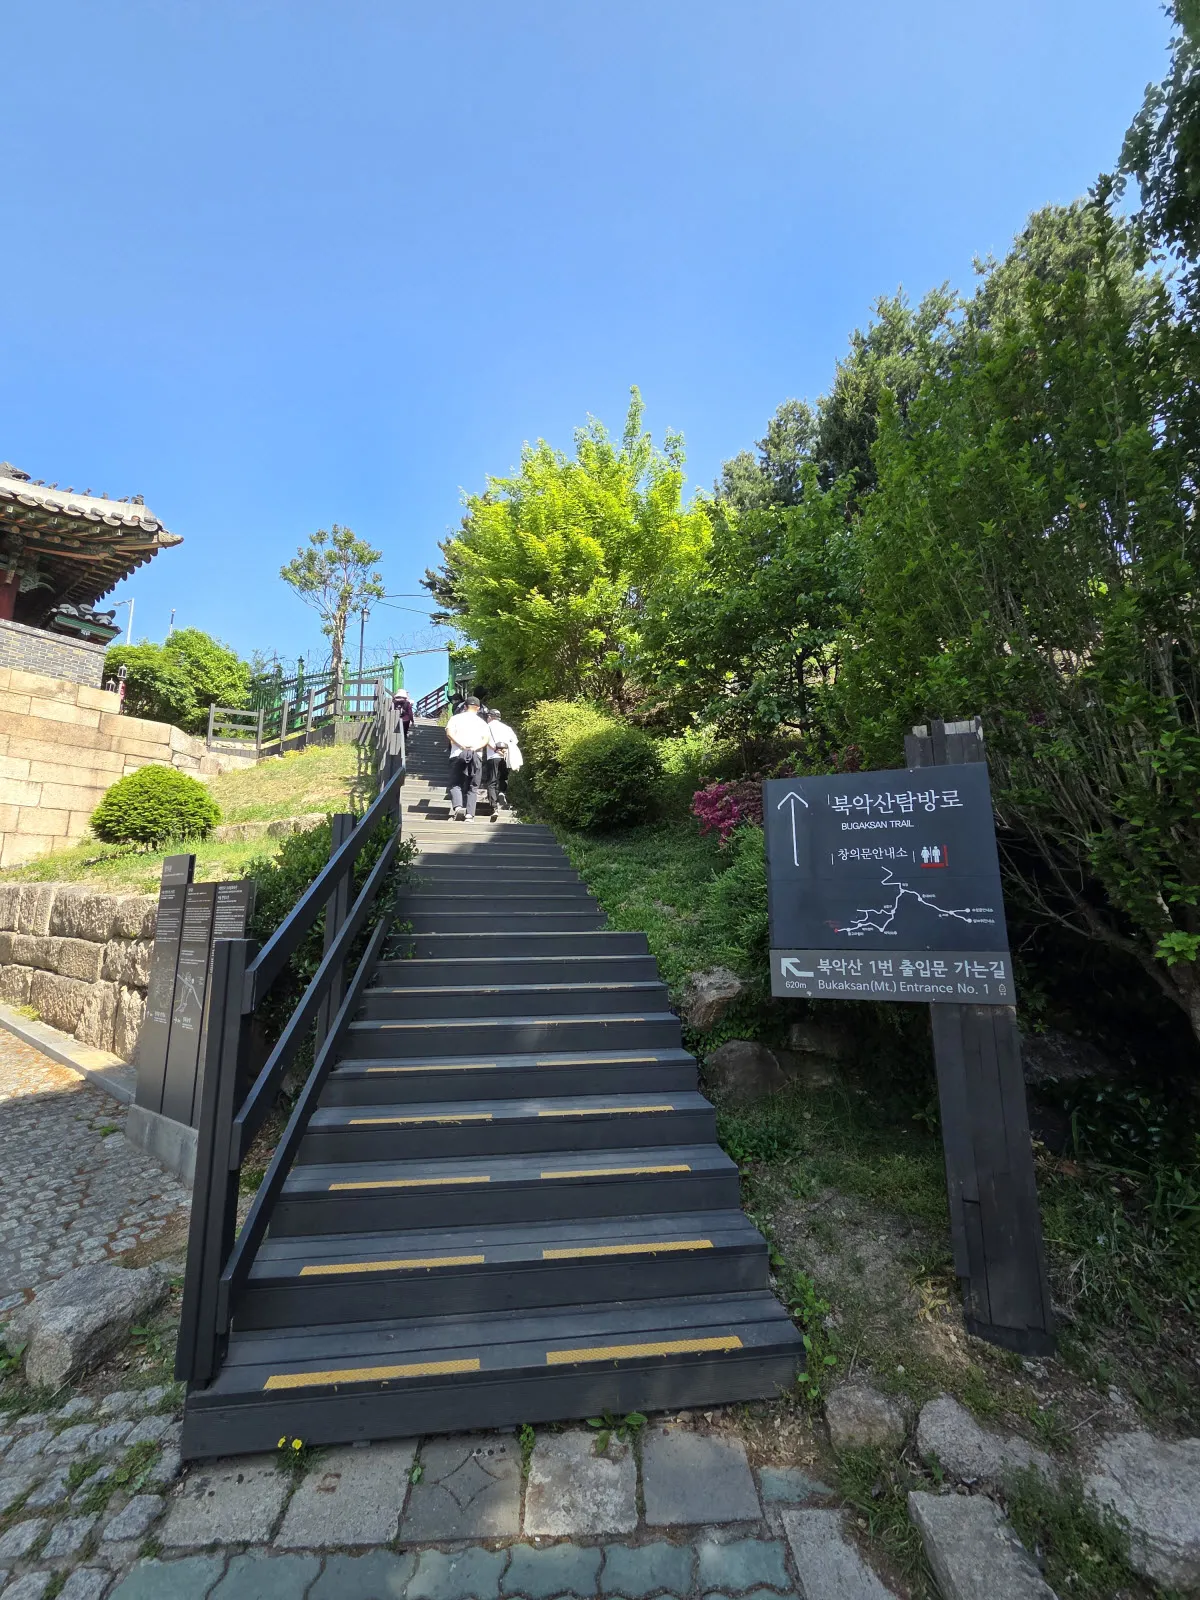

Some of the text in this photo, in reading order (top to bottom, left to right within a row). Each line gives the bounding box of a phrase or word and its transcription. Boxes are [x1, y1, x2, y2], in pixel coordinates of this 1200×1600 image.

[831, 790, 964, 816] 북악산탐방로
[841, 820, 914, 830] BUGAKSAN TRAIL
[837, 846, 909, 861] 창의문안내소
[816, 958, 1006, 979] 북악산 1번 출입문 가는길
[785, 981, 807, 989] 620m
[818, 980, 989, 995] Bukaksan(Mt.) Entrance No. 1
